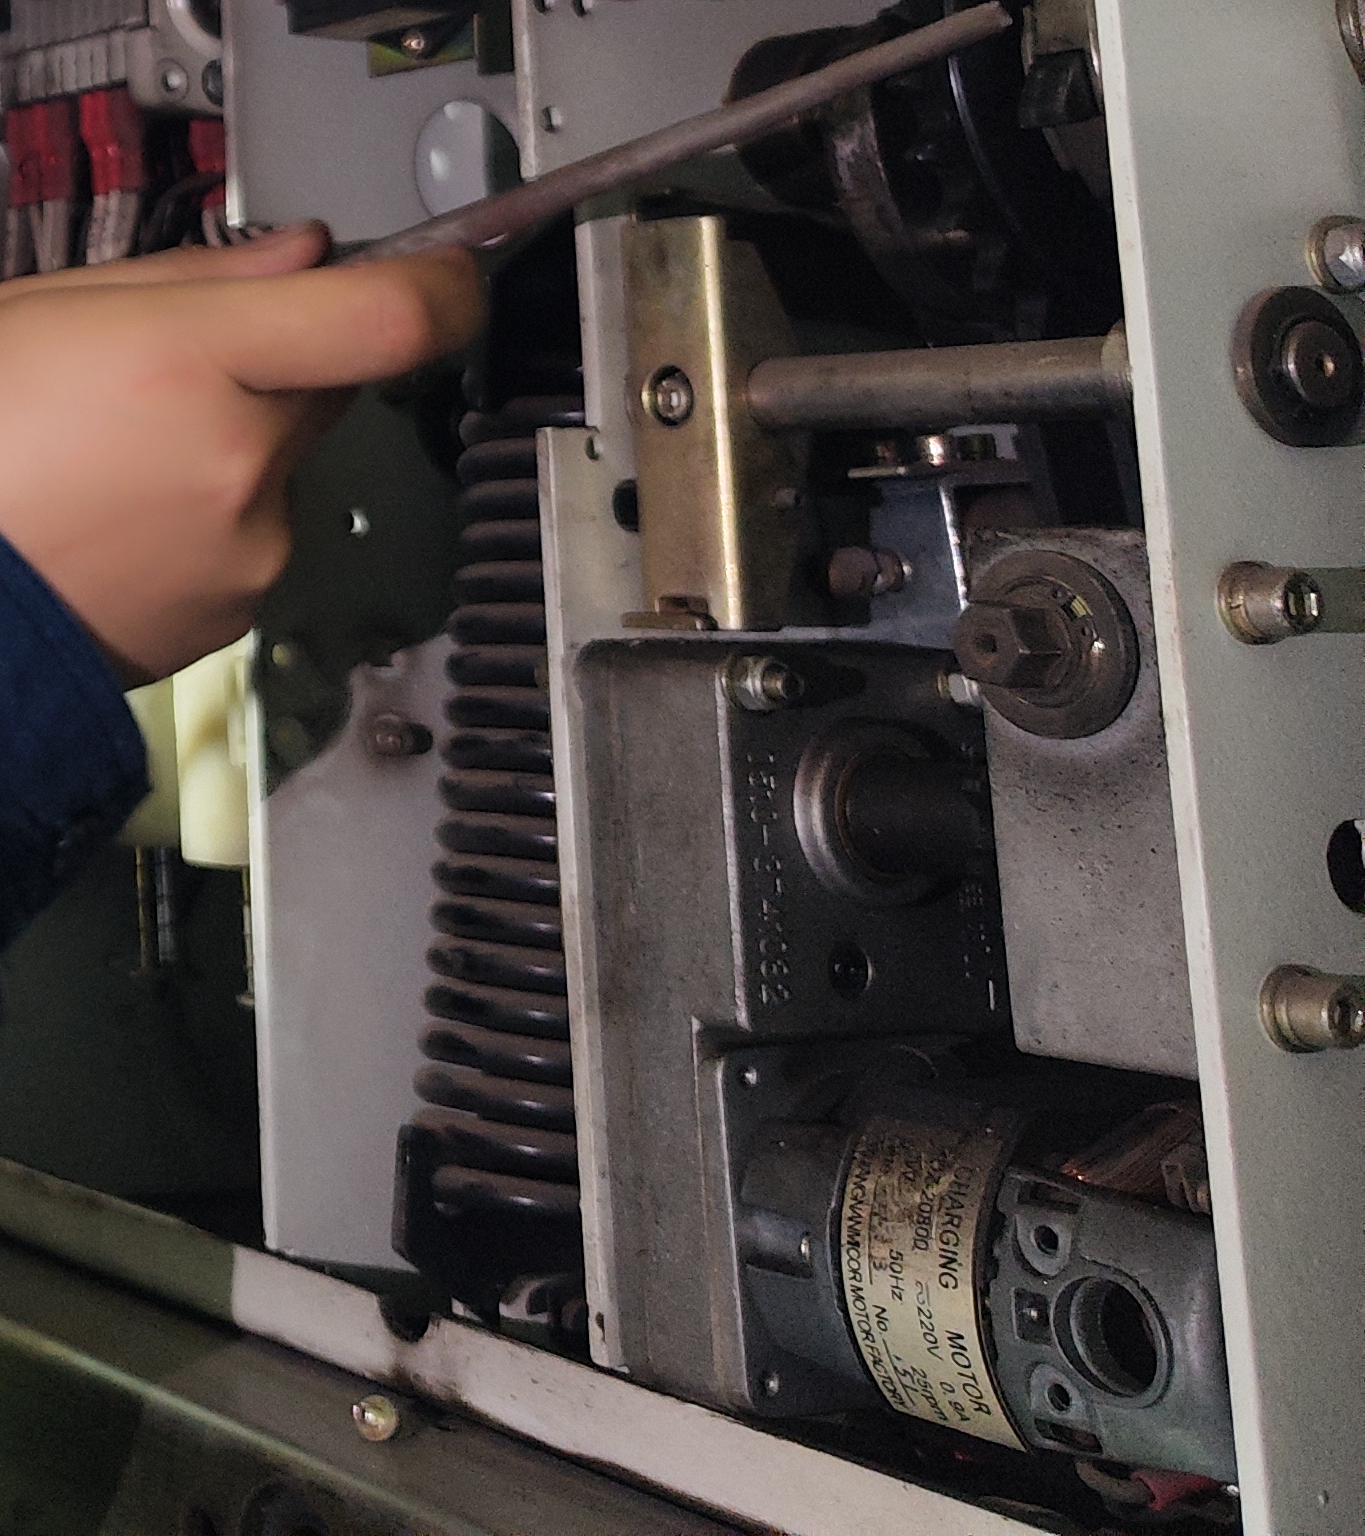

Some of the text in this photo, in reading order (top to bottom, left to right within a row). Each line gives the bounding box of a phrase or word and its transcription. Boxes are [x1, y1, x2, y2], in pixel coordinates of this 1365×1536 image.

[888, 1248, 905, 1302] 50Hz
[938, 1166, 992, 1416] CHARGING MOTOR
[850, 1284, 877, 1344] MOTOR
[865, 1344, 909, 1410] FACTORY
